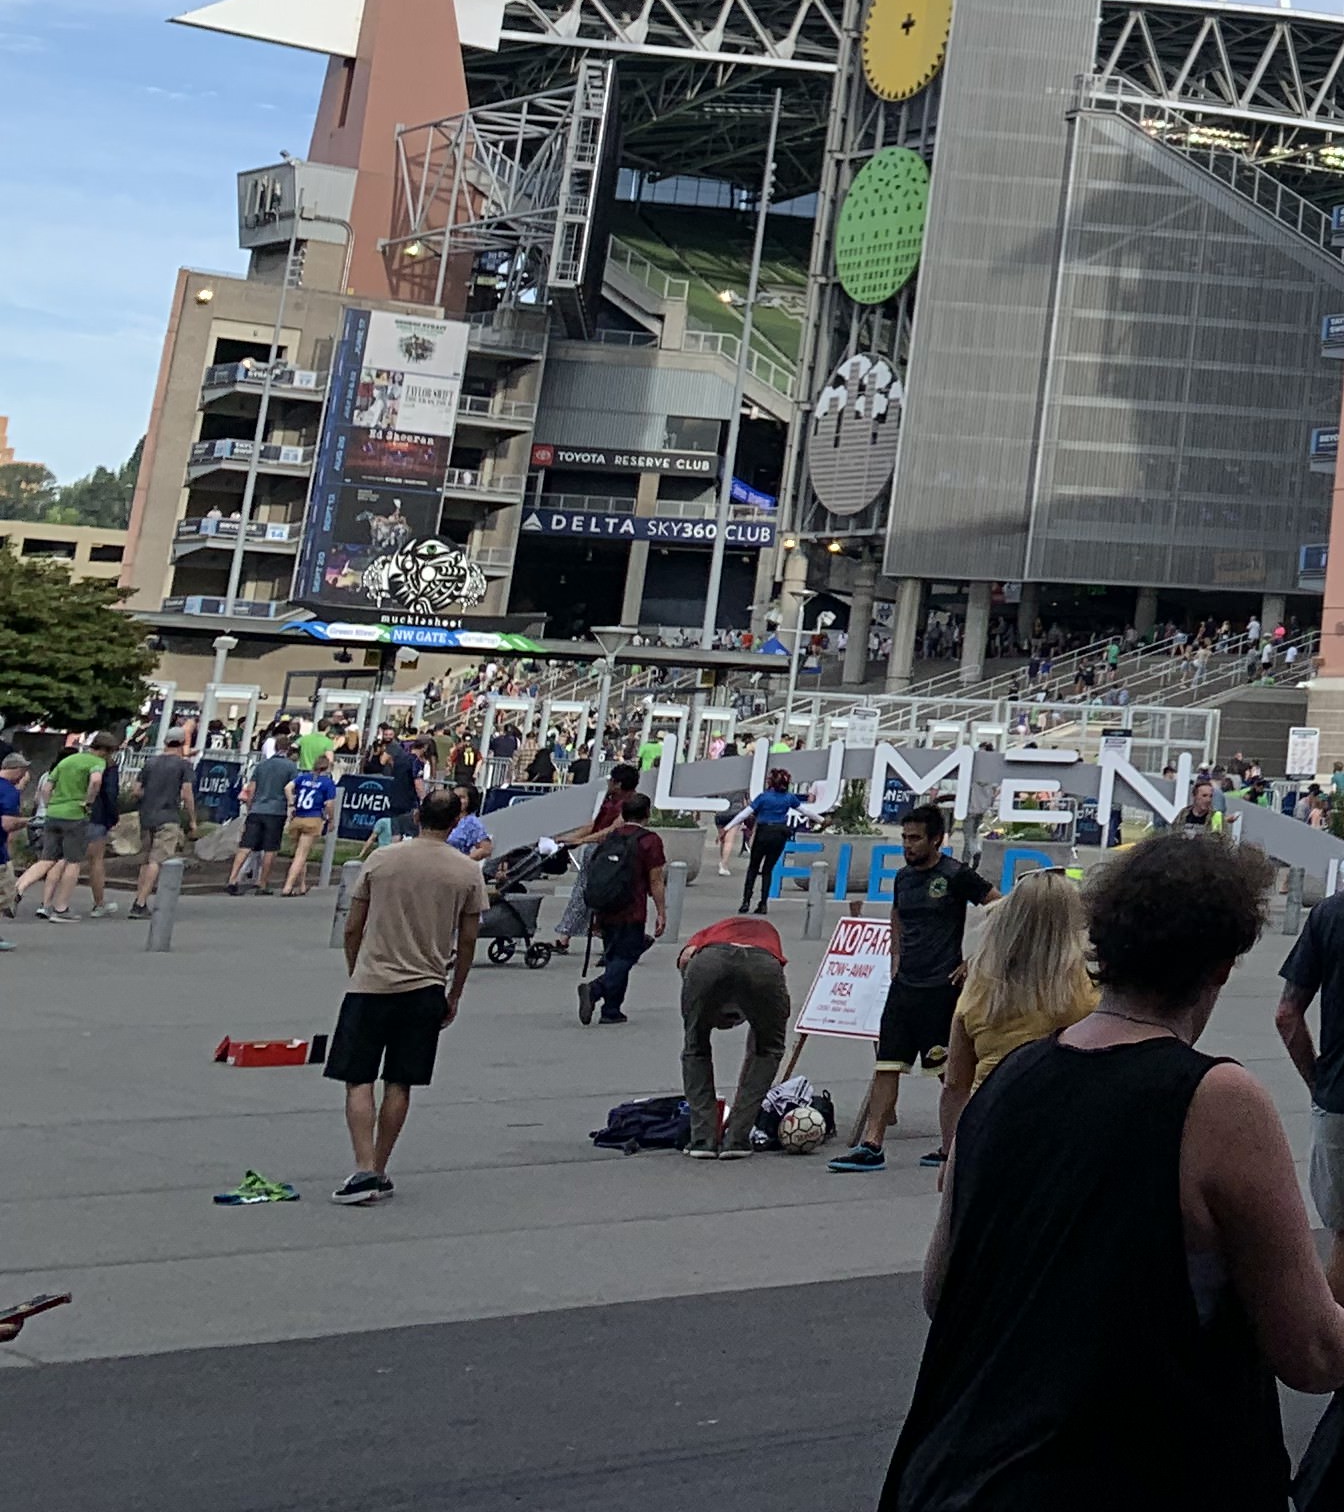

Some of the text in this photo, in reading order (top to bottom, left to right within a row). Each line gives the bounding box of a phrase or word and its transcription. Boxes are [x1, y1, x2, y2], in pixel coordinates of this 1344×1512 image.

[386, 430, 434, 445] Sheeran
[558, 451, 710, 471] TOYOTA RESERVE CLUB
[551, 514, 771, 542] DELTA SKY360 CLUB
[393, 631, 448, 643] NW GATE
[655, 733, 1191, 825] LUMEN
[297, 789, 316, 809] 16
[831, 923, 861, 953] NO
[826, 961, 875, 979] TOW-AWAY
[829, 982, 853, 997] AREA
